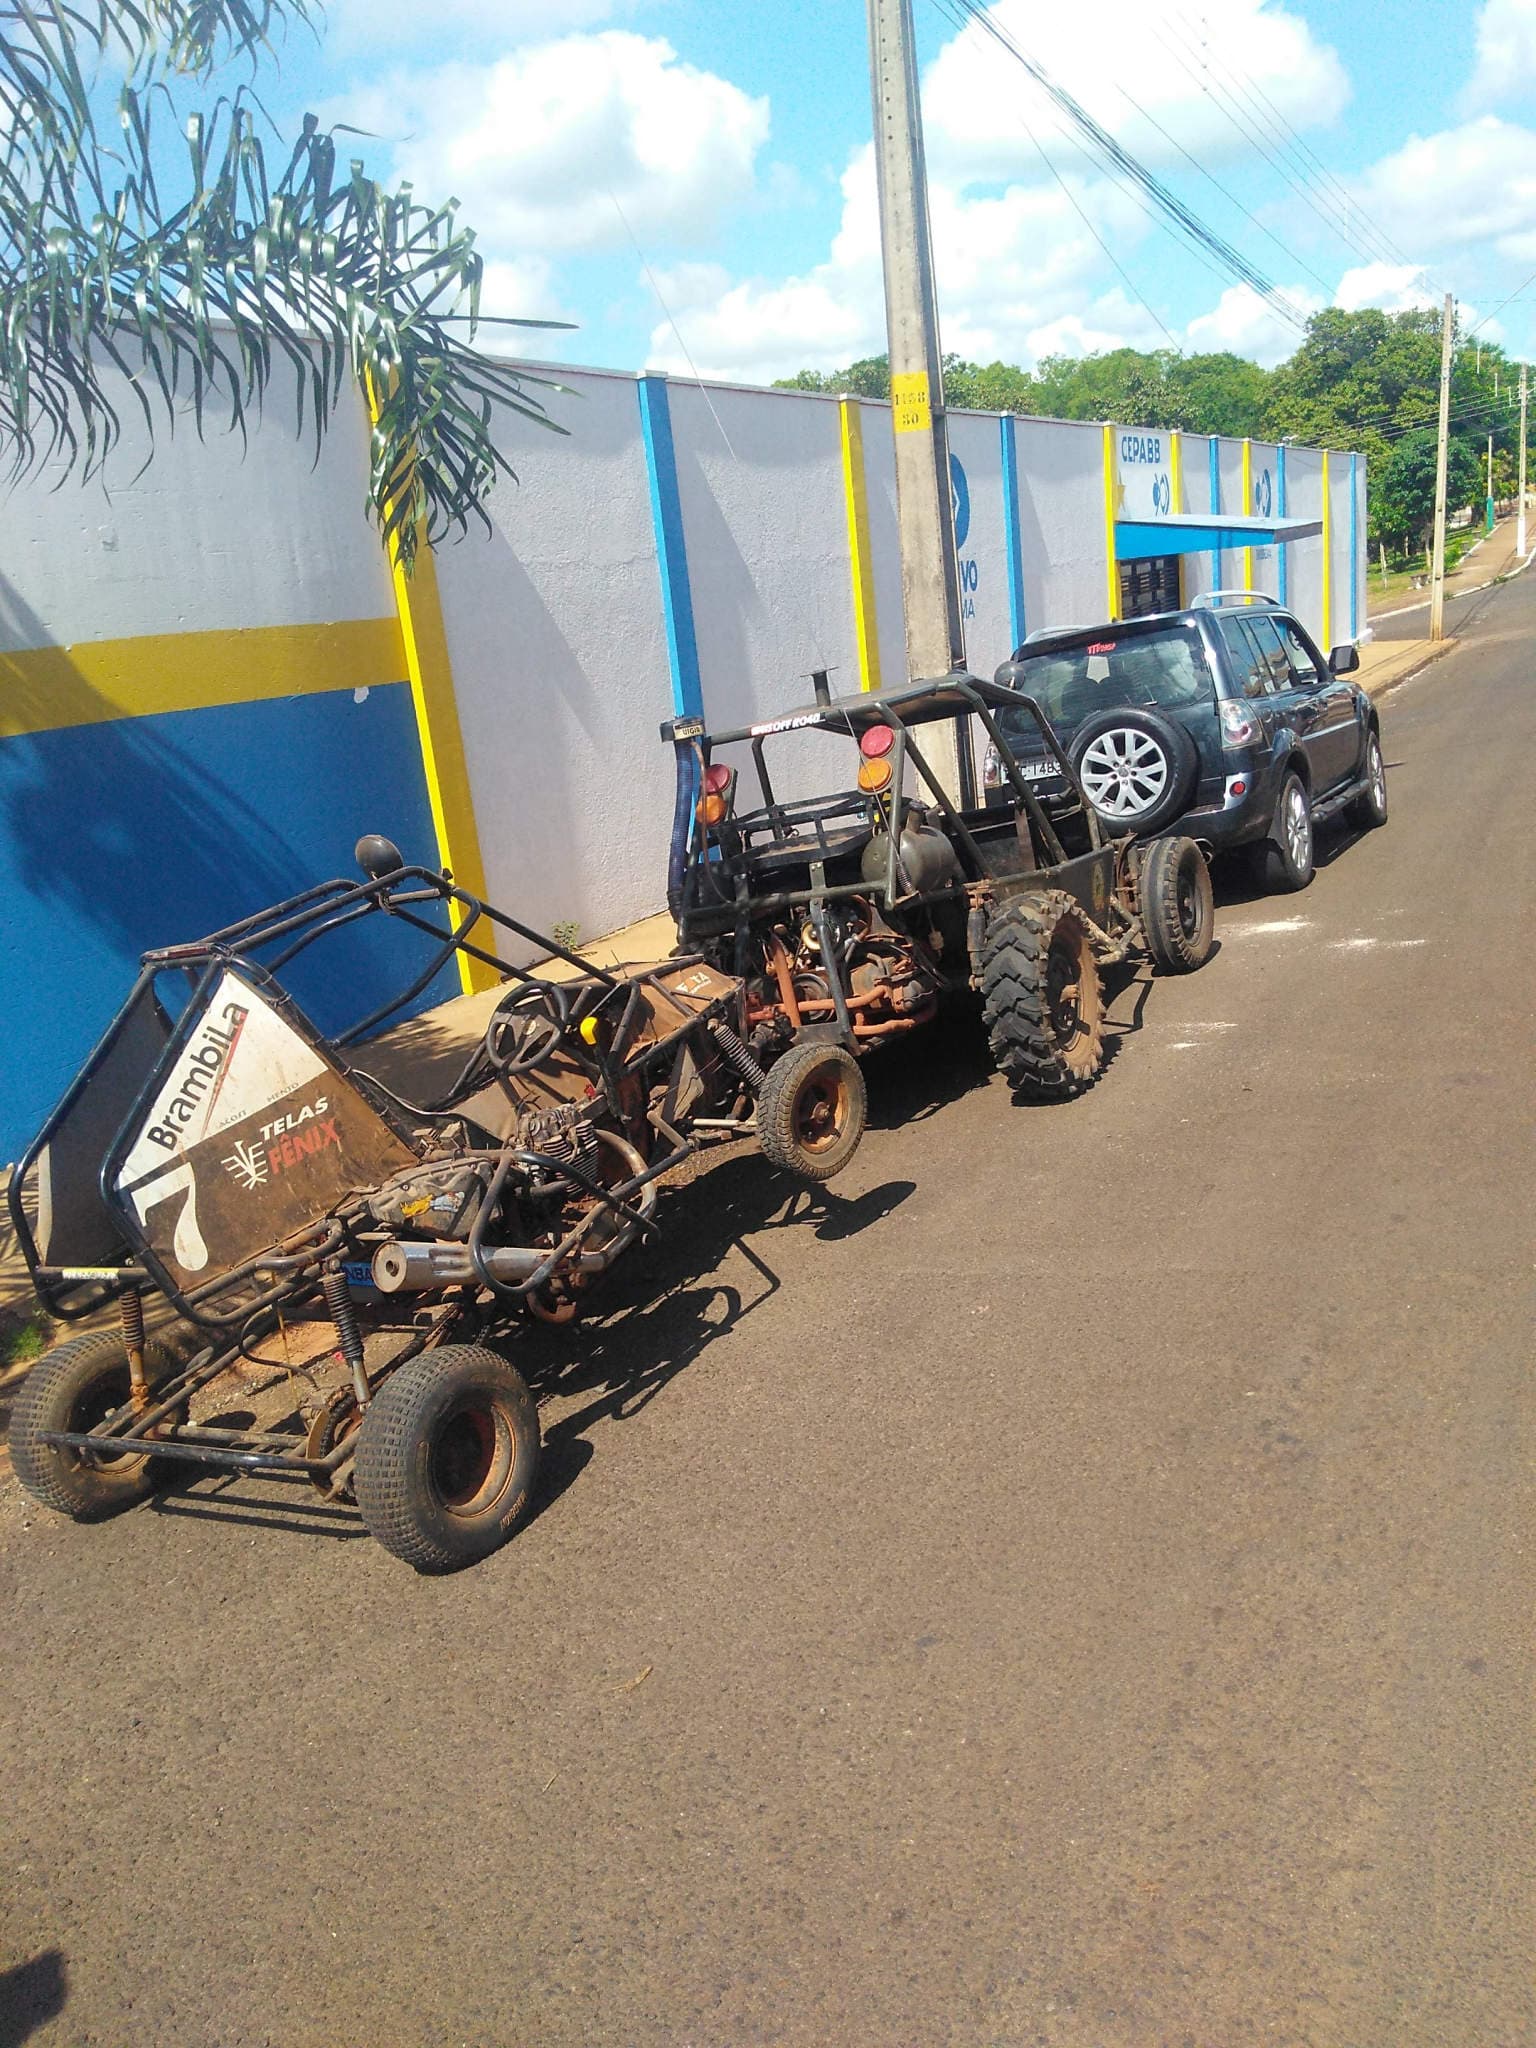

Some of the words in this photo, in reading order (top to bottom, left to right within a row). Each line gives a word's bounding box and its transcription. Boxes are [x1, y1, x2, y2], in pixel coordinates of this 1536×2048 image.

[1121, 436, 1161, 463] CEPABB
[260, 1096, 329, 1141] TELAS
[267, 1116, 339, 1175] FÊNIX
[130, 1161, 209, 1272] 7
